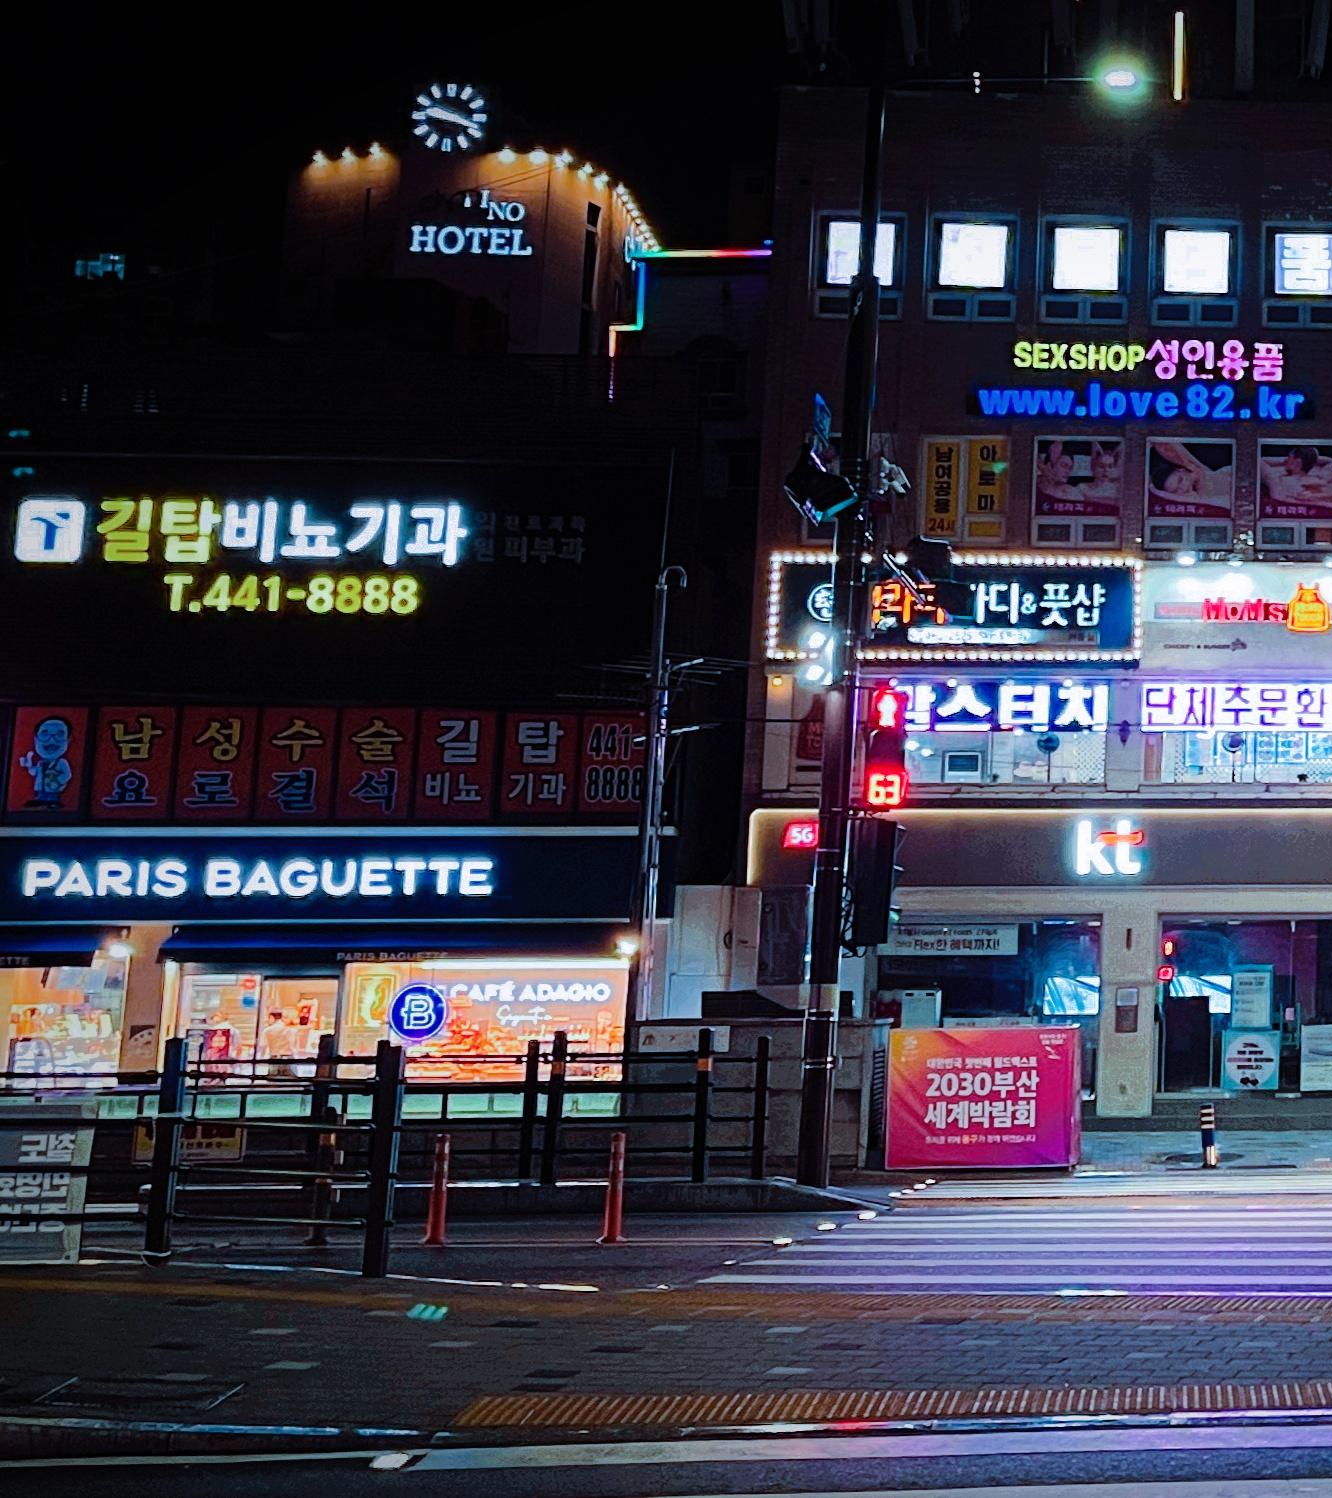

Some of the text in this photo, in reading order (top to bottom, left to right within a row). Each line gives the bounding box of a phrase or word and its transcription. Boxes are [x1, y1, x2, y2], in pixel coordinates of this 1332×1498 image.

[408, 224, 533, 256] HOTEL
[1145, 339, 1284, 382] 성인용품
[978, 381, 1305, 420] www.love82.kr
[97, 497, 468, 567] 길탑비뇨기과
[163, 572, 419, 614] T.441-8888
[868, 773, 901, 806] 63
[790, 826, 814, 845] 5G
[1075, 819, 1144, 875] kt
[22, 858, 494, 897] PARIS BAGUETTE
[336, 951, 376, 962] PARIS
[518, 983, 612, 1002] ADAGIO
[925, 1070, 1040, 1098] 2030부산
[924, 1100, 1037, 1129] 세계박람회
